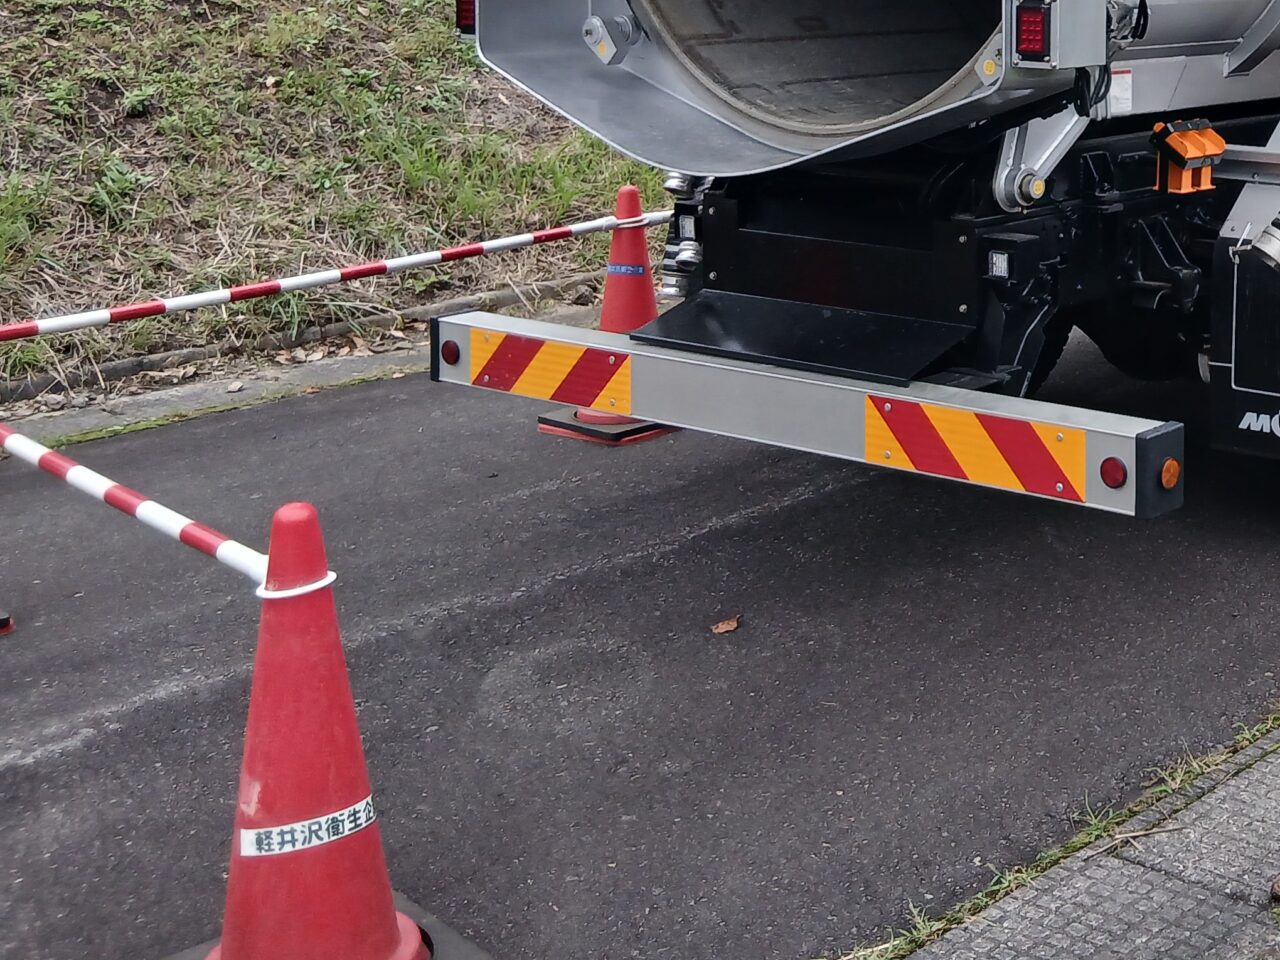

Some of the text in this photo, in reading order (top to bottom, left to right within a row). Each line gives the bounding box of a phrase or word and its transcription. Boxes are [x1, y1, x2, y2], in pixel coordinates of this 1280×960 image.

[255, 797, 376, 853] 軽井沢衛生企
